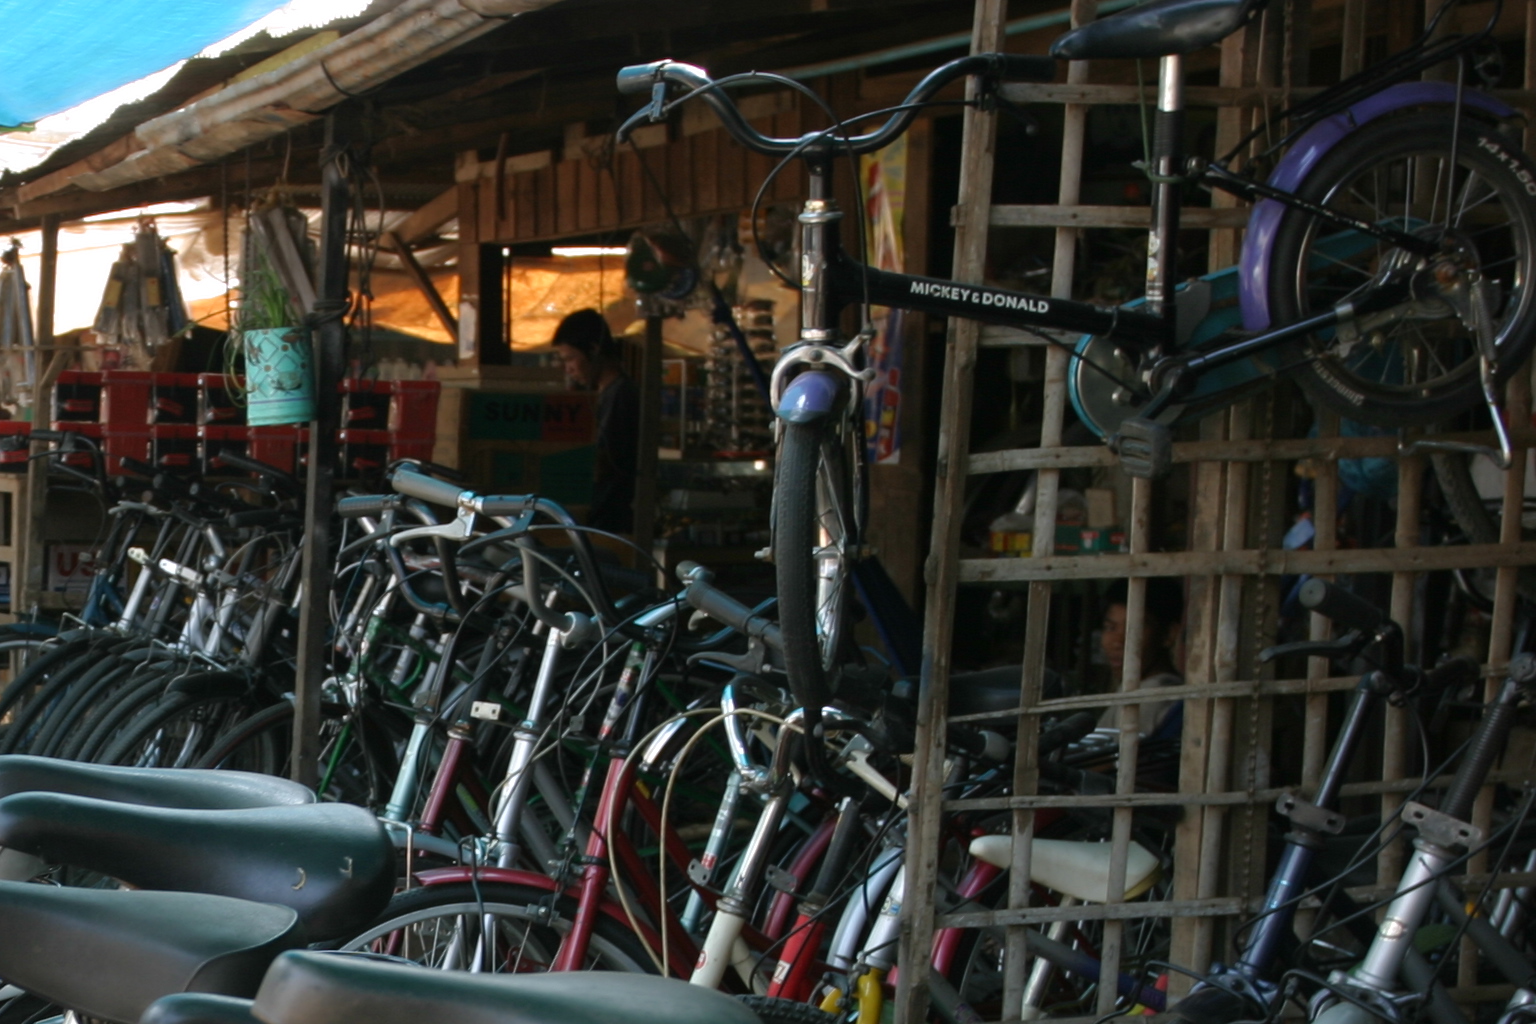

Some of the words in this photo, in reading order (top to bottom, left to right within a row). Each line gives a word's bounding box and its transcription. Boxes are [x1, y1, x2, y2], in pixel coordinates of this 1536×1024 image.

[909, 280, 971, 302] MICKEY
[982, 292, 1050, 314] DONALD
[484, 400, 583, 423] SUNNY
